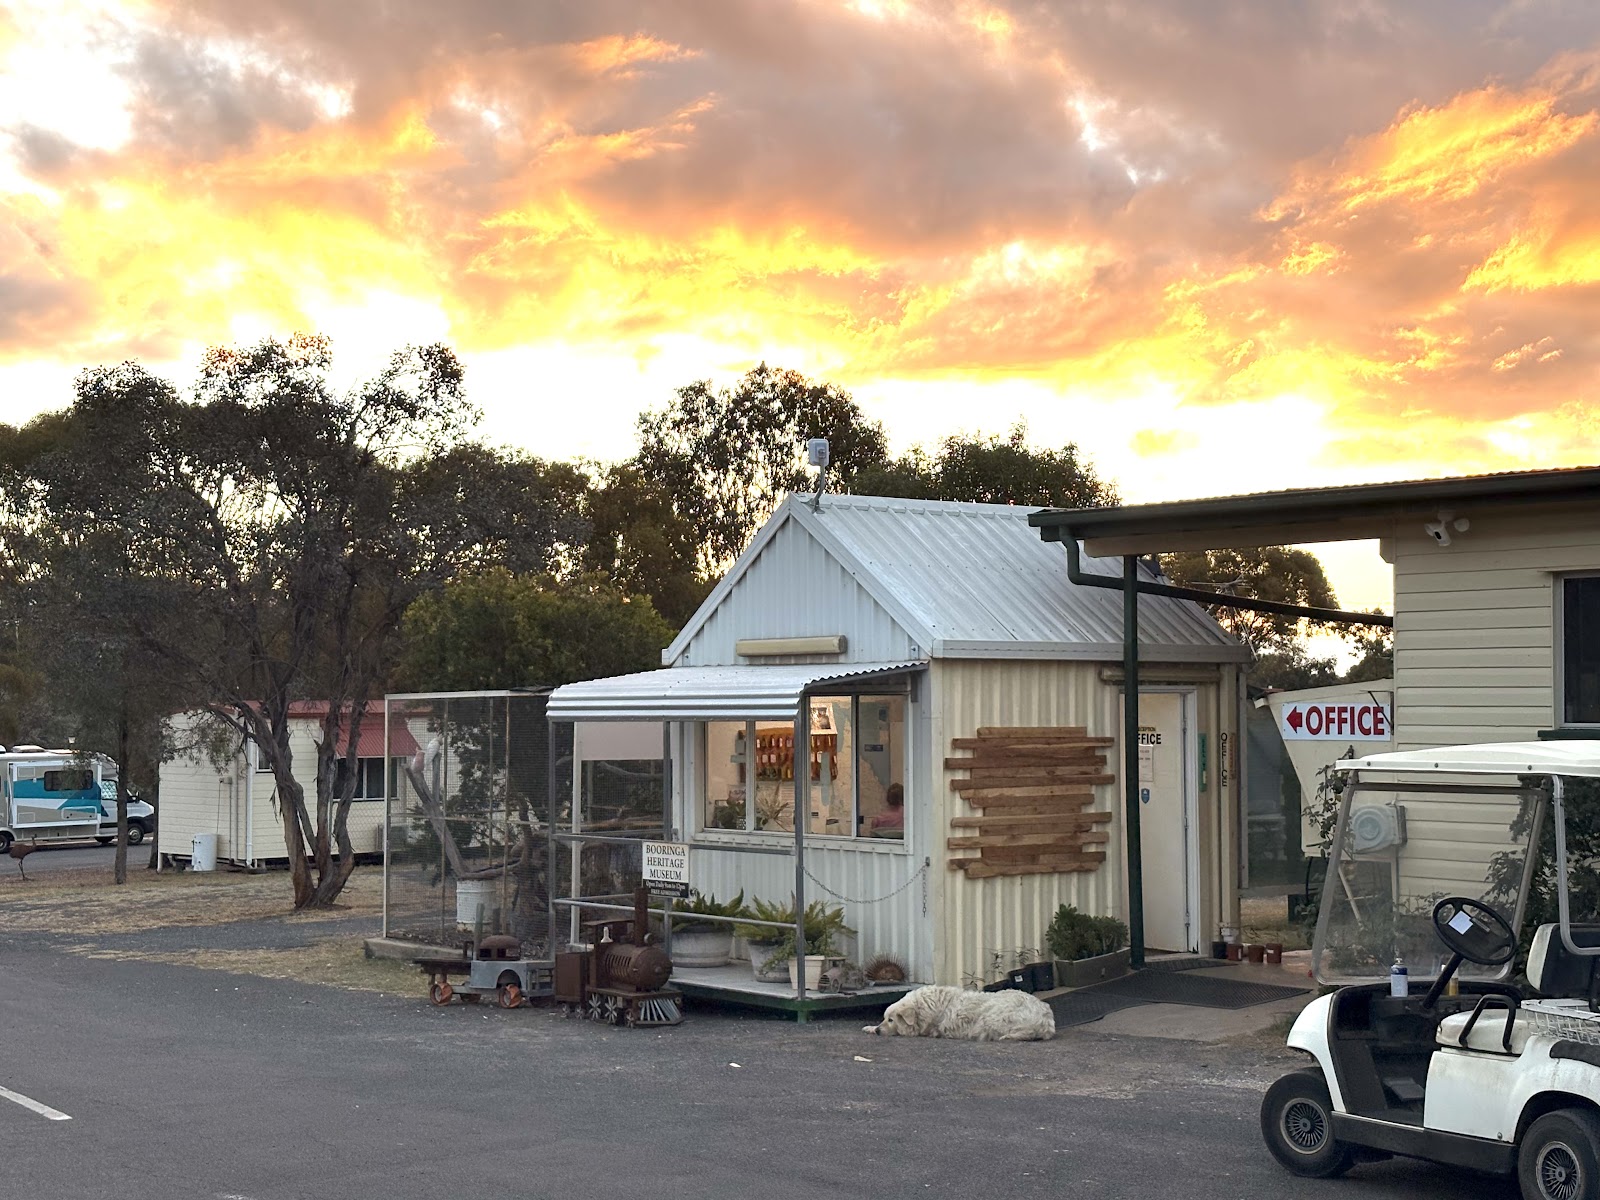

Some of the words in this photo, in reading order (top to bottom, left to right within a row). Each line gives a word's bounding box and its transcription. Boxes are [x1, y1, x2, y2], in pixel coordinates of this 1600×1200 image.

[1306, 706, 1384, 735] OFFICE
[1137, 733, 1161, 744] FFICE
[646, 845, 685, 856] BOORINGA
[647, 857, 684, 868] HERITAGE
[650, 869, 682, 880] MUSEUM
